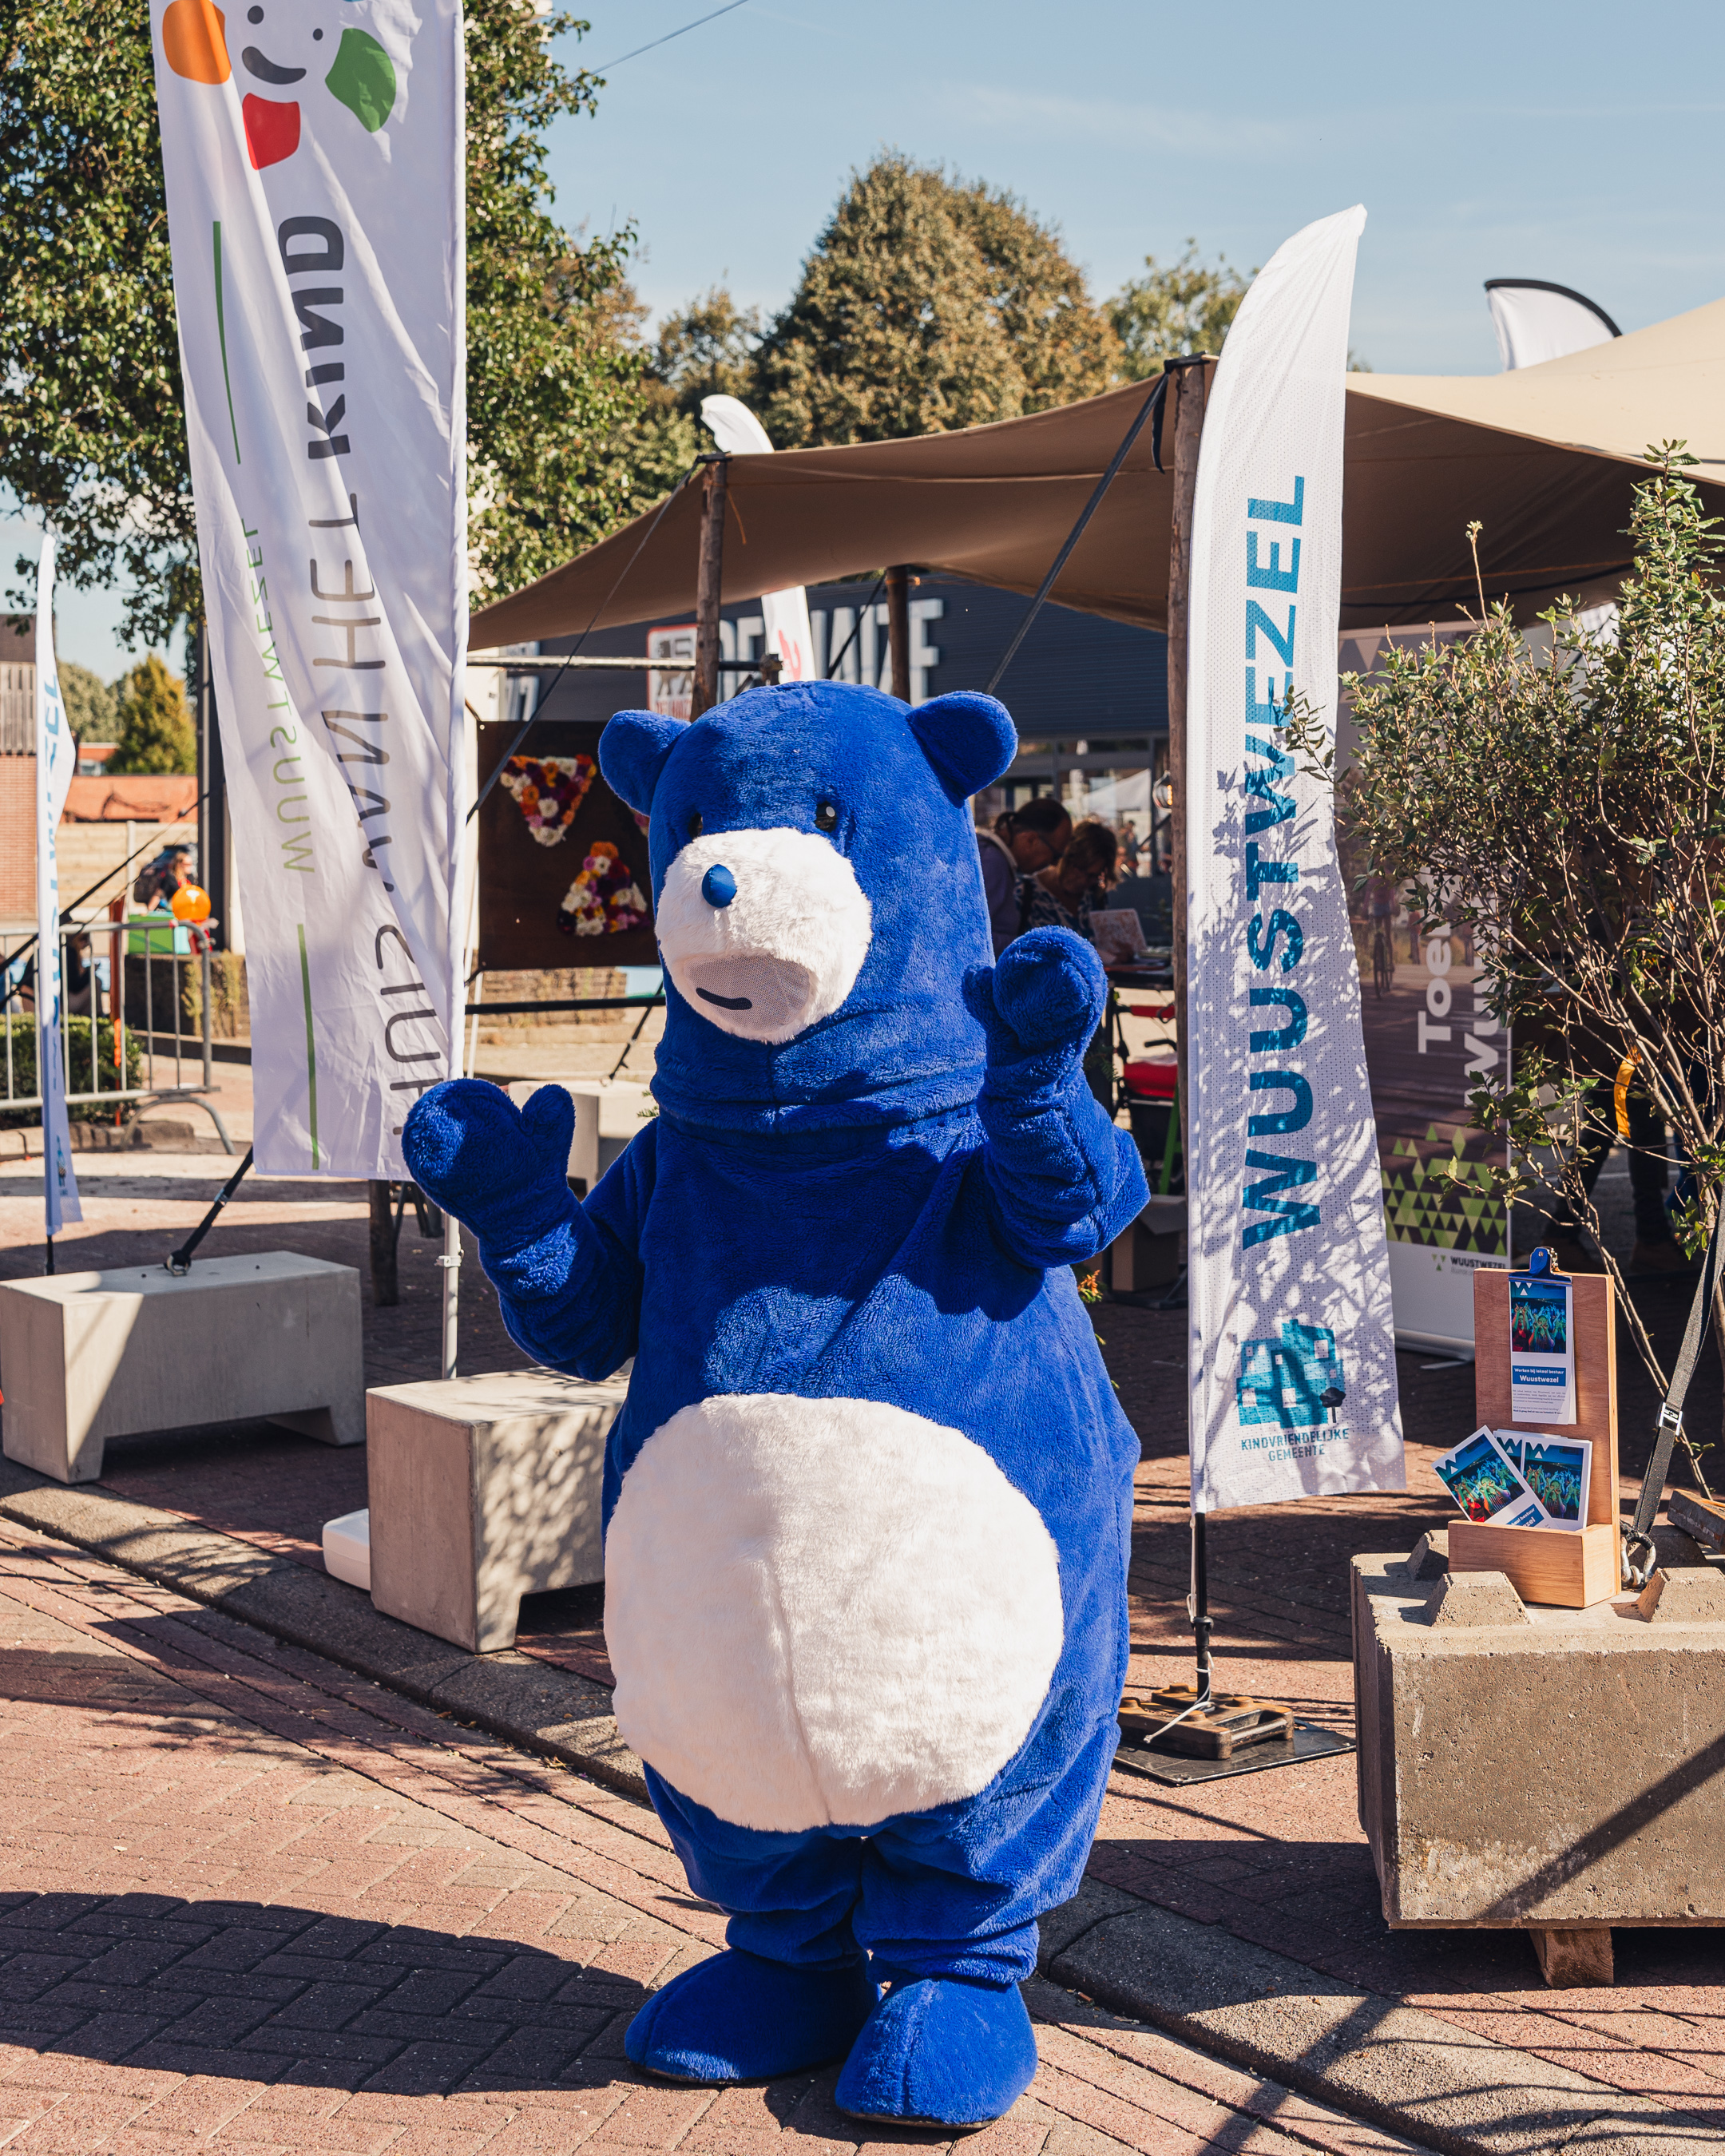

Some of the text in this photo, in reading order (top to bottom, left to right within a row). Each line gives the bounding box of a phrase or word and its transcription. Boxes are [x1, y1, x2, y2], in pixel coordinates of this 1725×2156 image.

[1243, 475, 1322, 1250] WUUSTWEZEL
[1241, 1428, 1350, 1451] KINDVRIENDELIJKE
[1268, 1444, 1326, 1461] GEMEENTE
